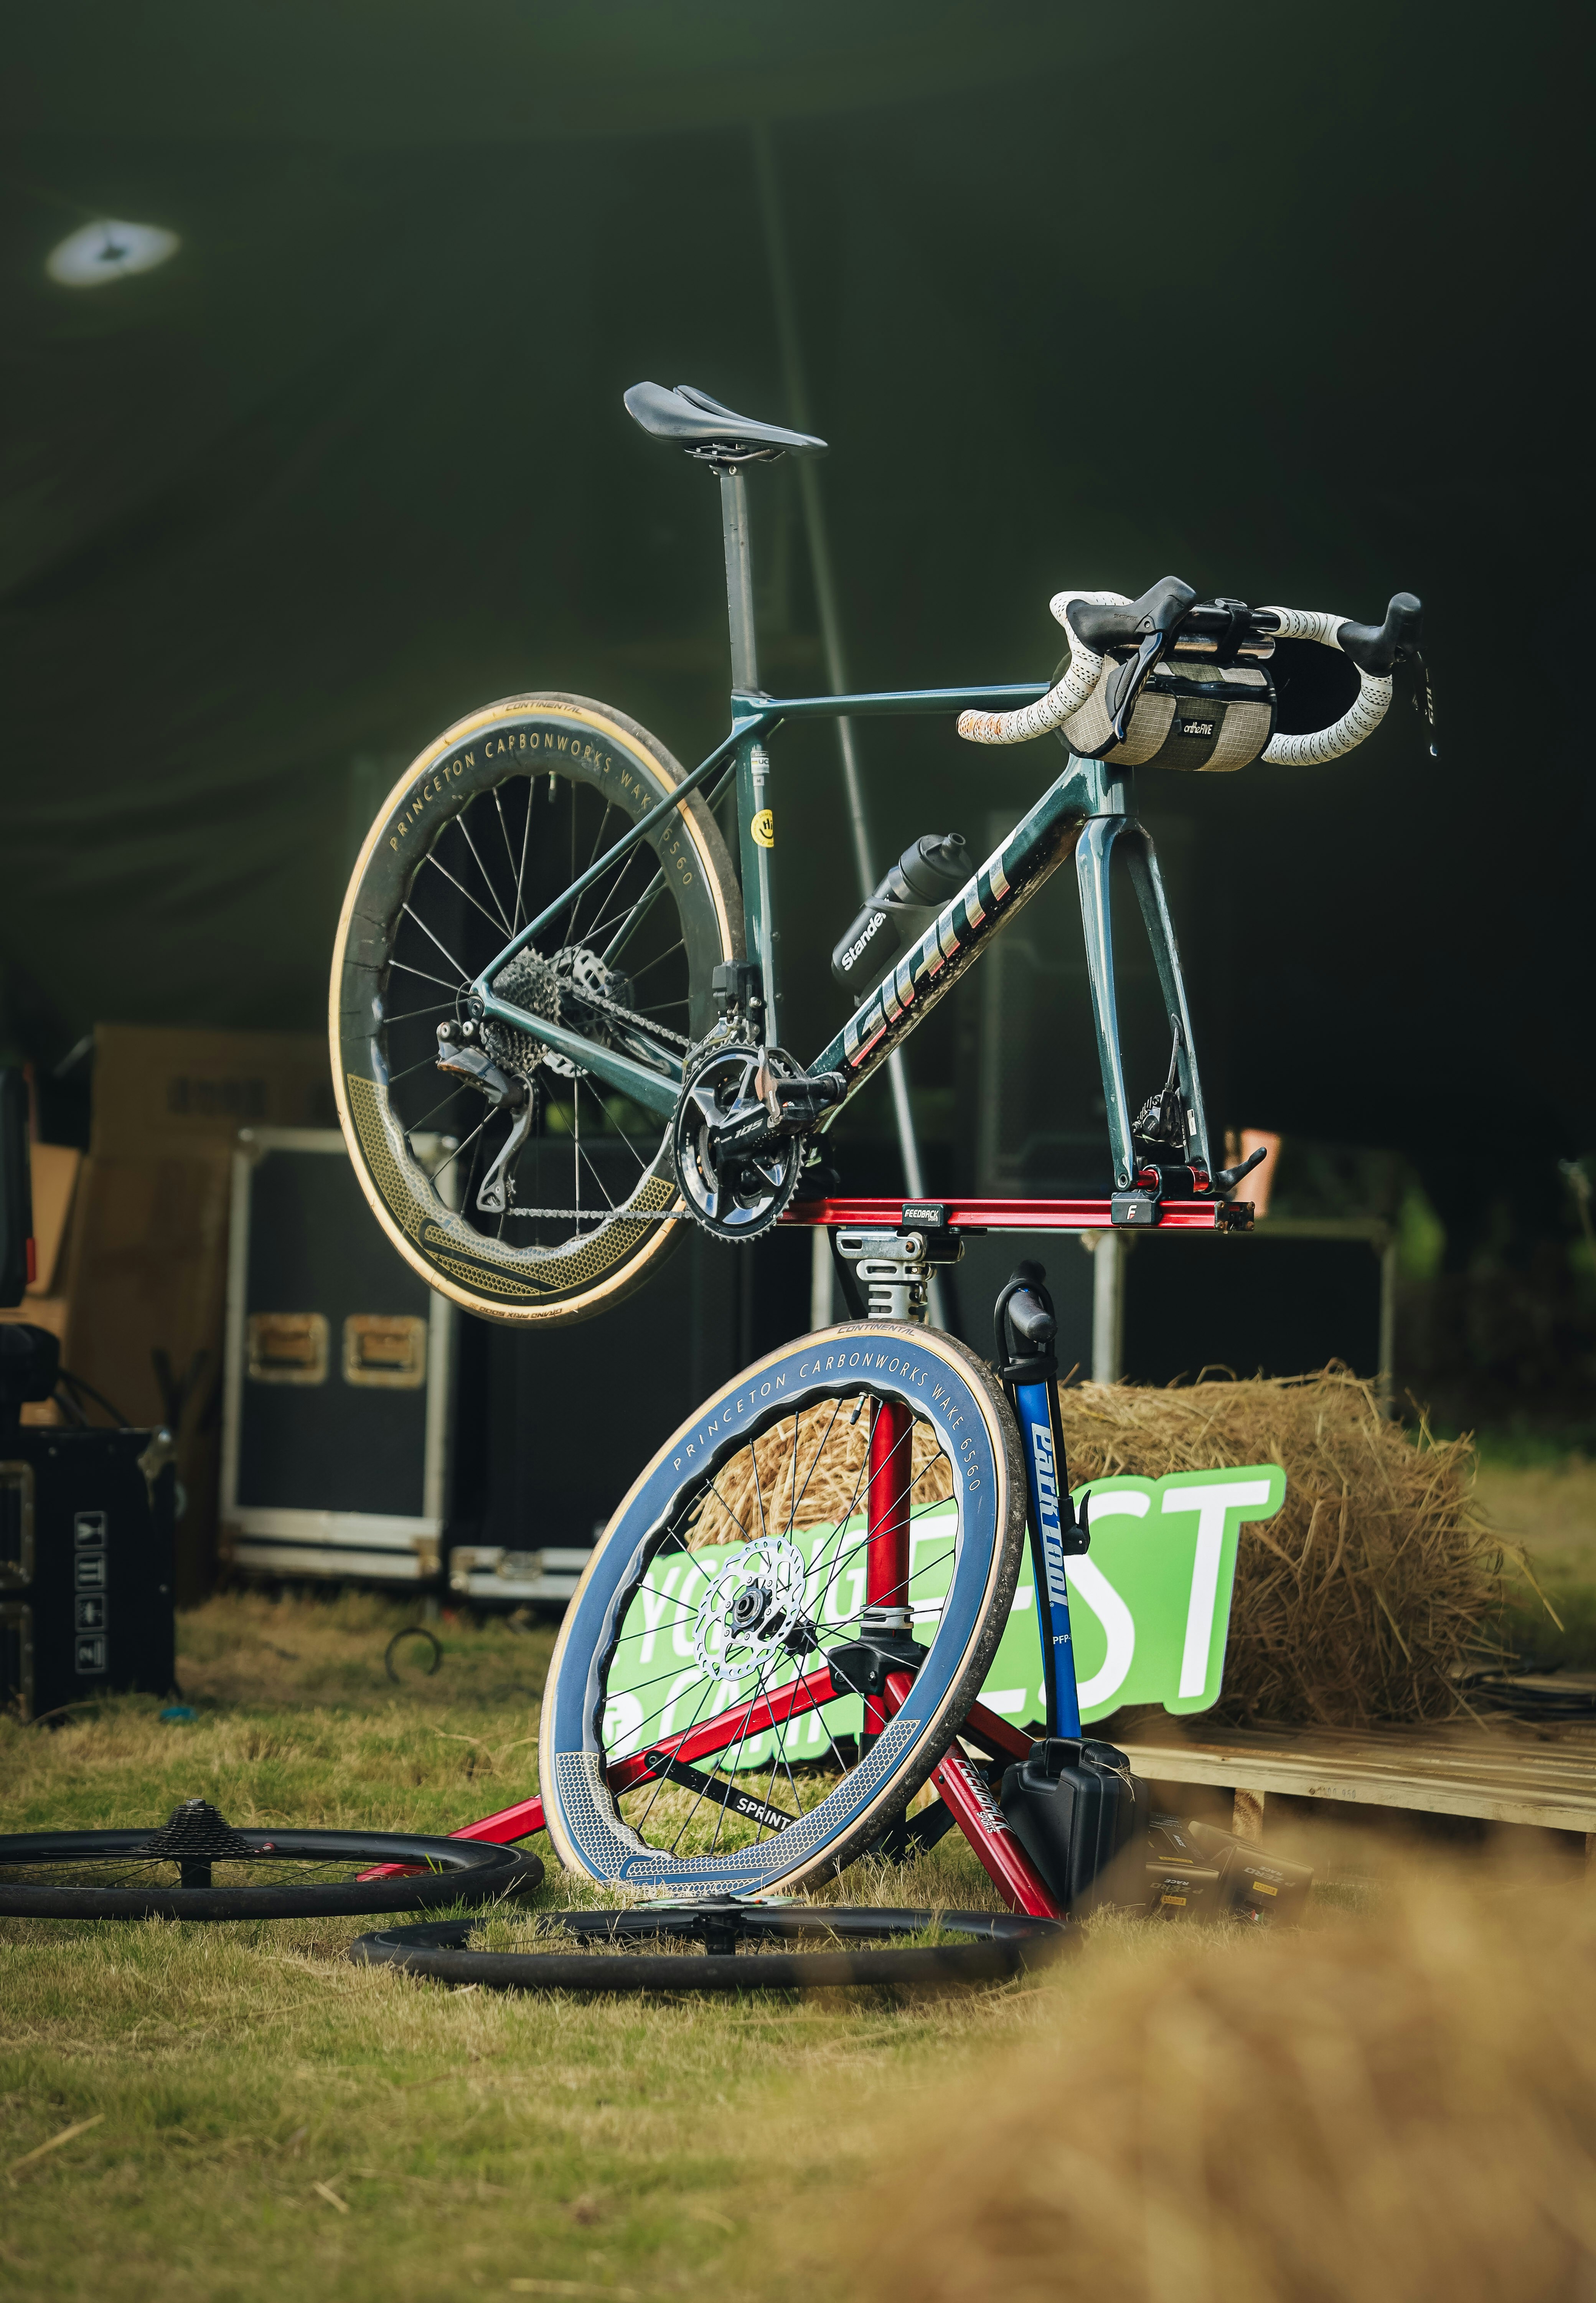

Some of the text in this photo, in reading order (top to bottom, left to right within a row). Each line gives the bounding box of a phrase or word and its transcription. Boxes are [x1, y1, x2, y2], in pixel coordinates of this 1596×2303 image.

[504, 699, 582, 715] CONTINENTAL
[389, 752, 476, 852] PRINCETON
[484, 732, 612, 773] CARBONWORKS
[660, 827, 692, 886] 6560
[734, 1118, 764, 1139] 105
[904, 1209, 939, 1218] FEEDBACK
[480, 1306, 505, 1317] 5000
[531, 1308, 562, 1318] GRAND
[837, 1323, 915, 1336] CONTINENTAL
[673, 1352, 980, 1491] PRINCETON CARBONWORKS WAKE 6560
[1031, 1422, 1059, 1522] Park
[954, 1759, 1017, 1835] FEEDBACK
[736, 1797, 791, 1830] SPRINT
[976, 1811, 996, 1834] SPORTS
[1243, 1867, 1284, 1883] ZERO
[1258, 1866, 1283, 1876] RACE
